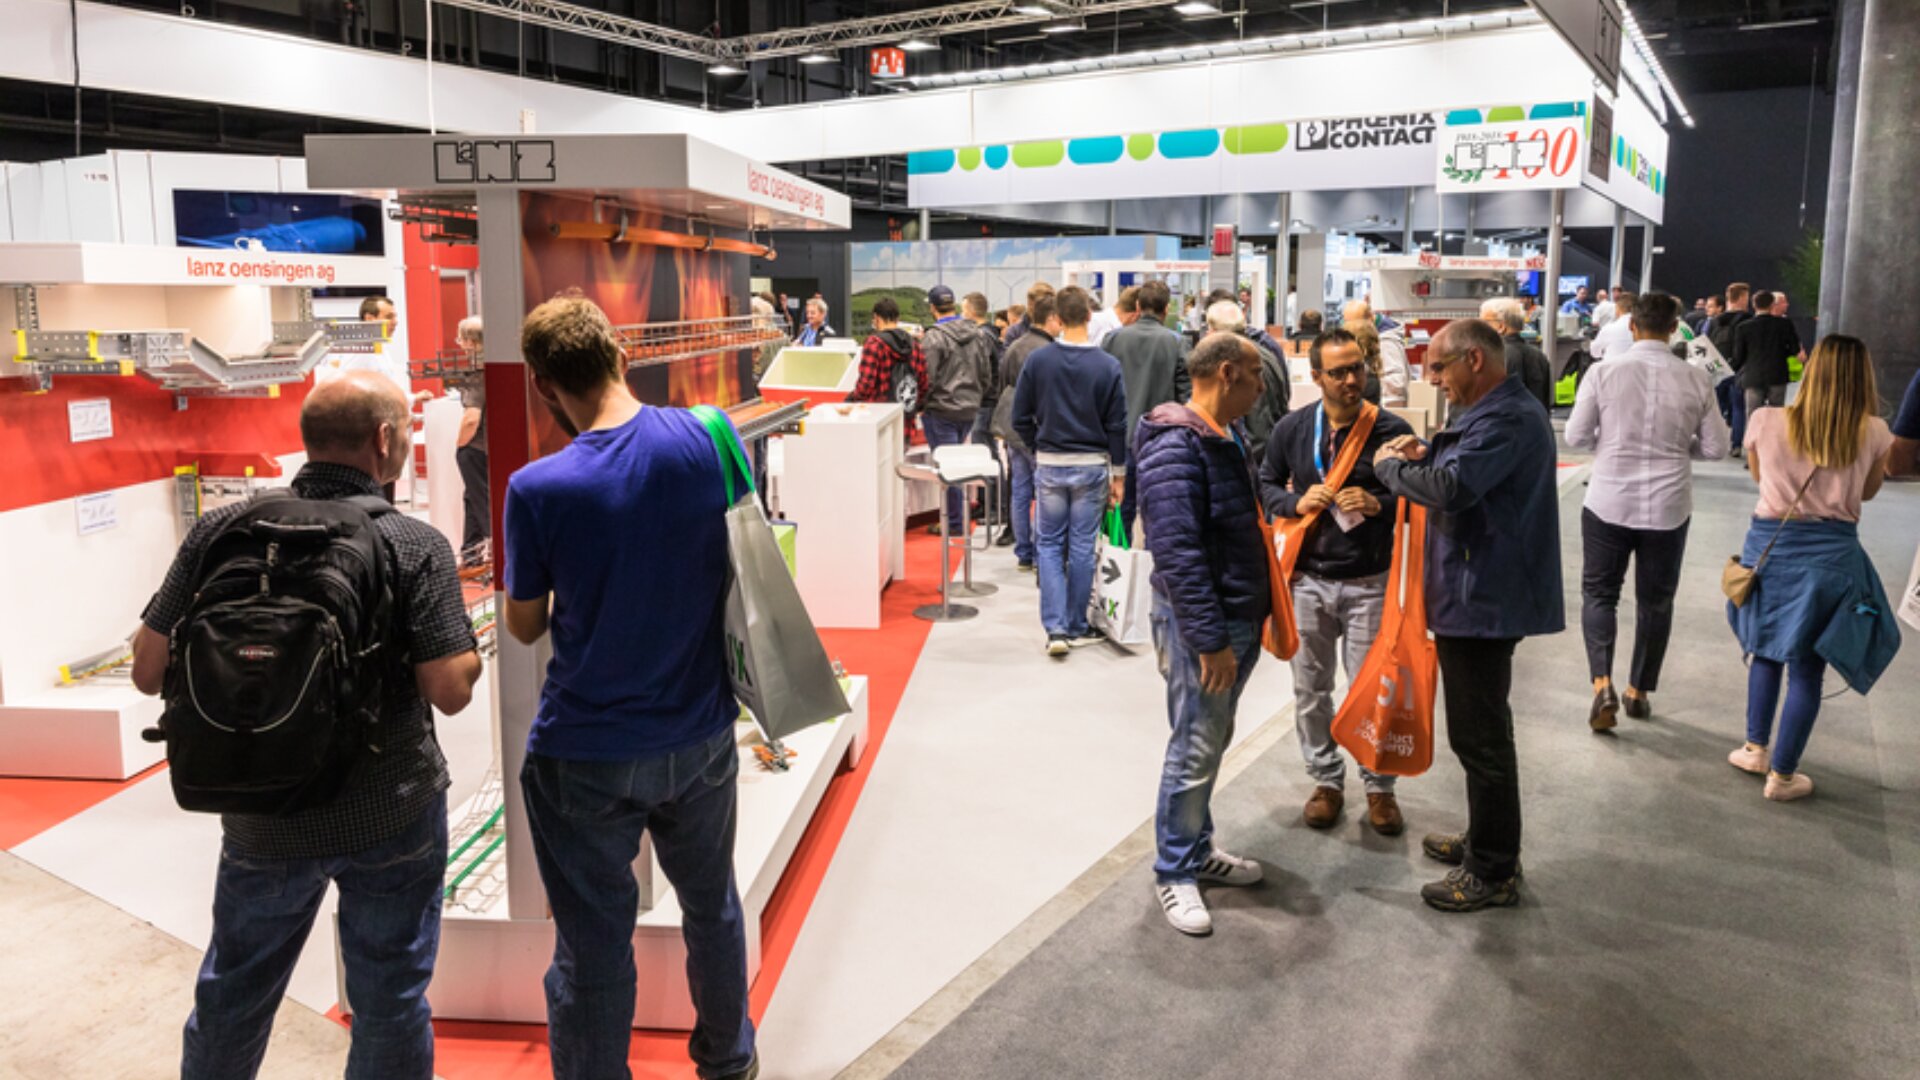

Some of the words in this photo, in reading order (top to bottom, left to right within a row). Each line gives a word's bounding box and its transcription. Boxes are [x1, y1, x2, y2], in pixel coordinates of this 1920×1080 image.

[1329, 126, 1437, 149] CONTACT
[747, 162, 769, 195] lanz
[770, 176, 813, 212] oensingen
[815, 191, 825, 217] ag
[186, 256, 226, 277] lanz
[229, 260, 314, 283] oensingen
[316, 264, 335, 283] ag
